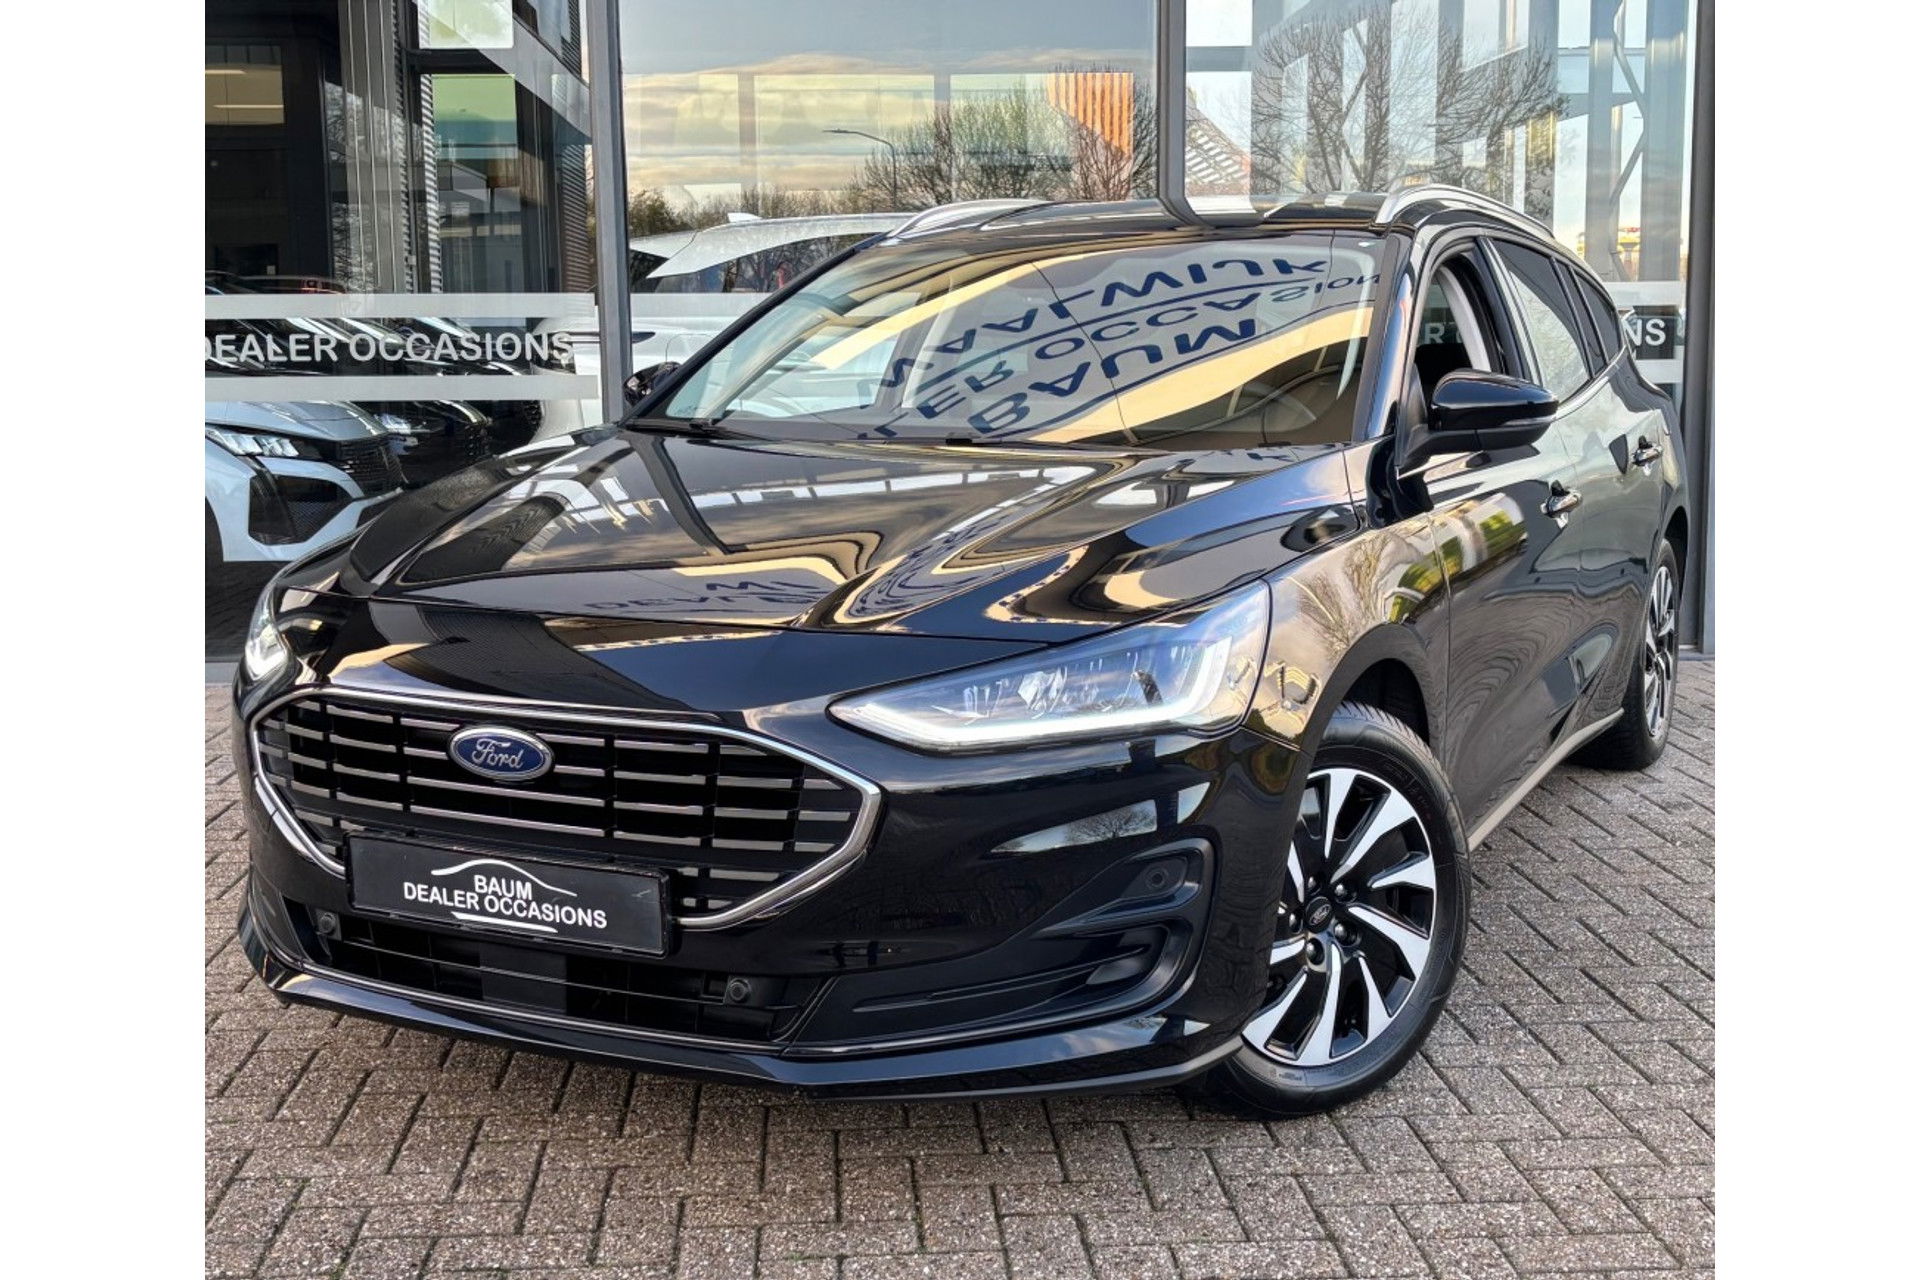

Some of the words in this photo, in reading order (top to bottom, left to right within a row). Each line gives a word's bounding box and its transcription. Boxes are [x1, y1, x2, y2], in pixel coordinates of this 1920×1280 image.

[350, 332, 574, 362] OCCASIONS
[472, 738, 525, 769] Ford
[474, 874, 532, 900] BAUM
[403, 881, 480, 911] DEALER
[484, 895, 608, 929] OCCASIONS
